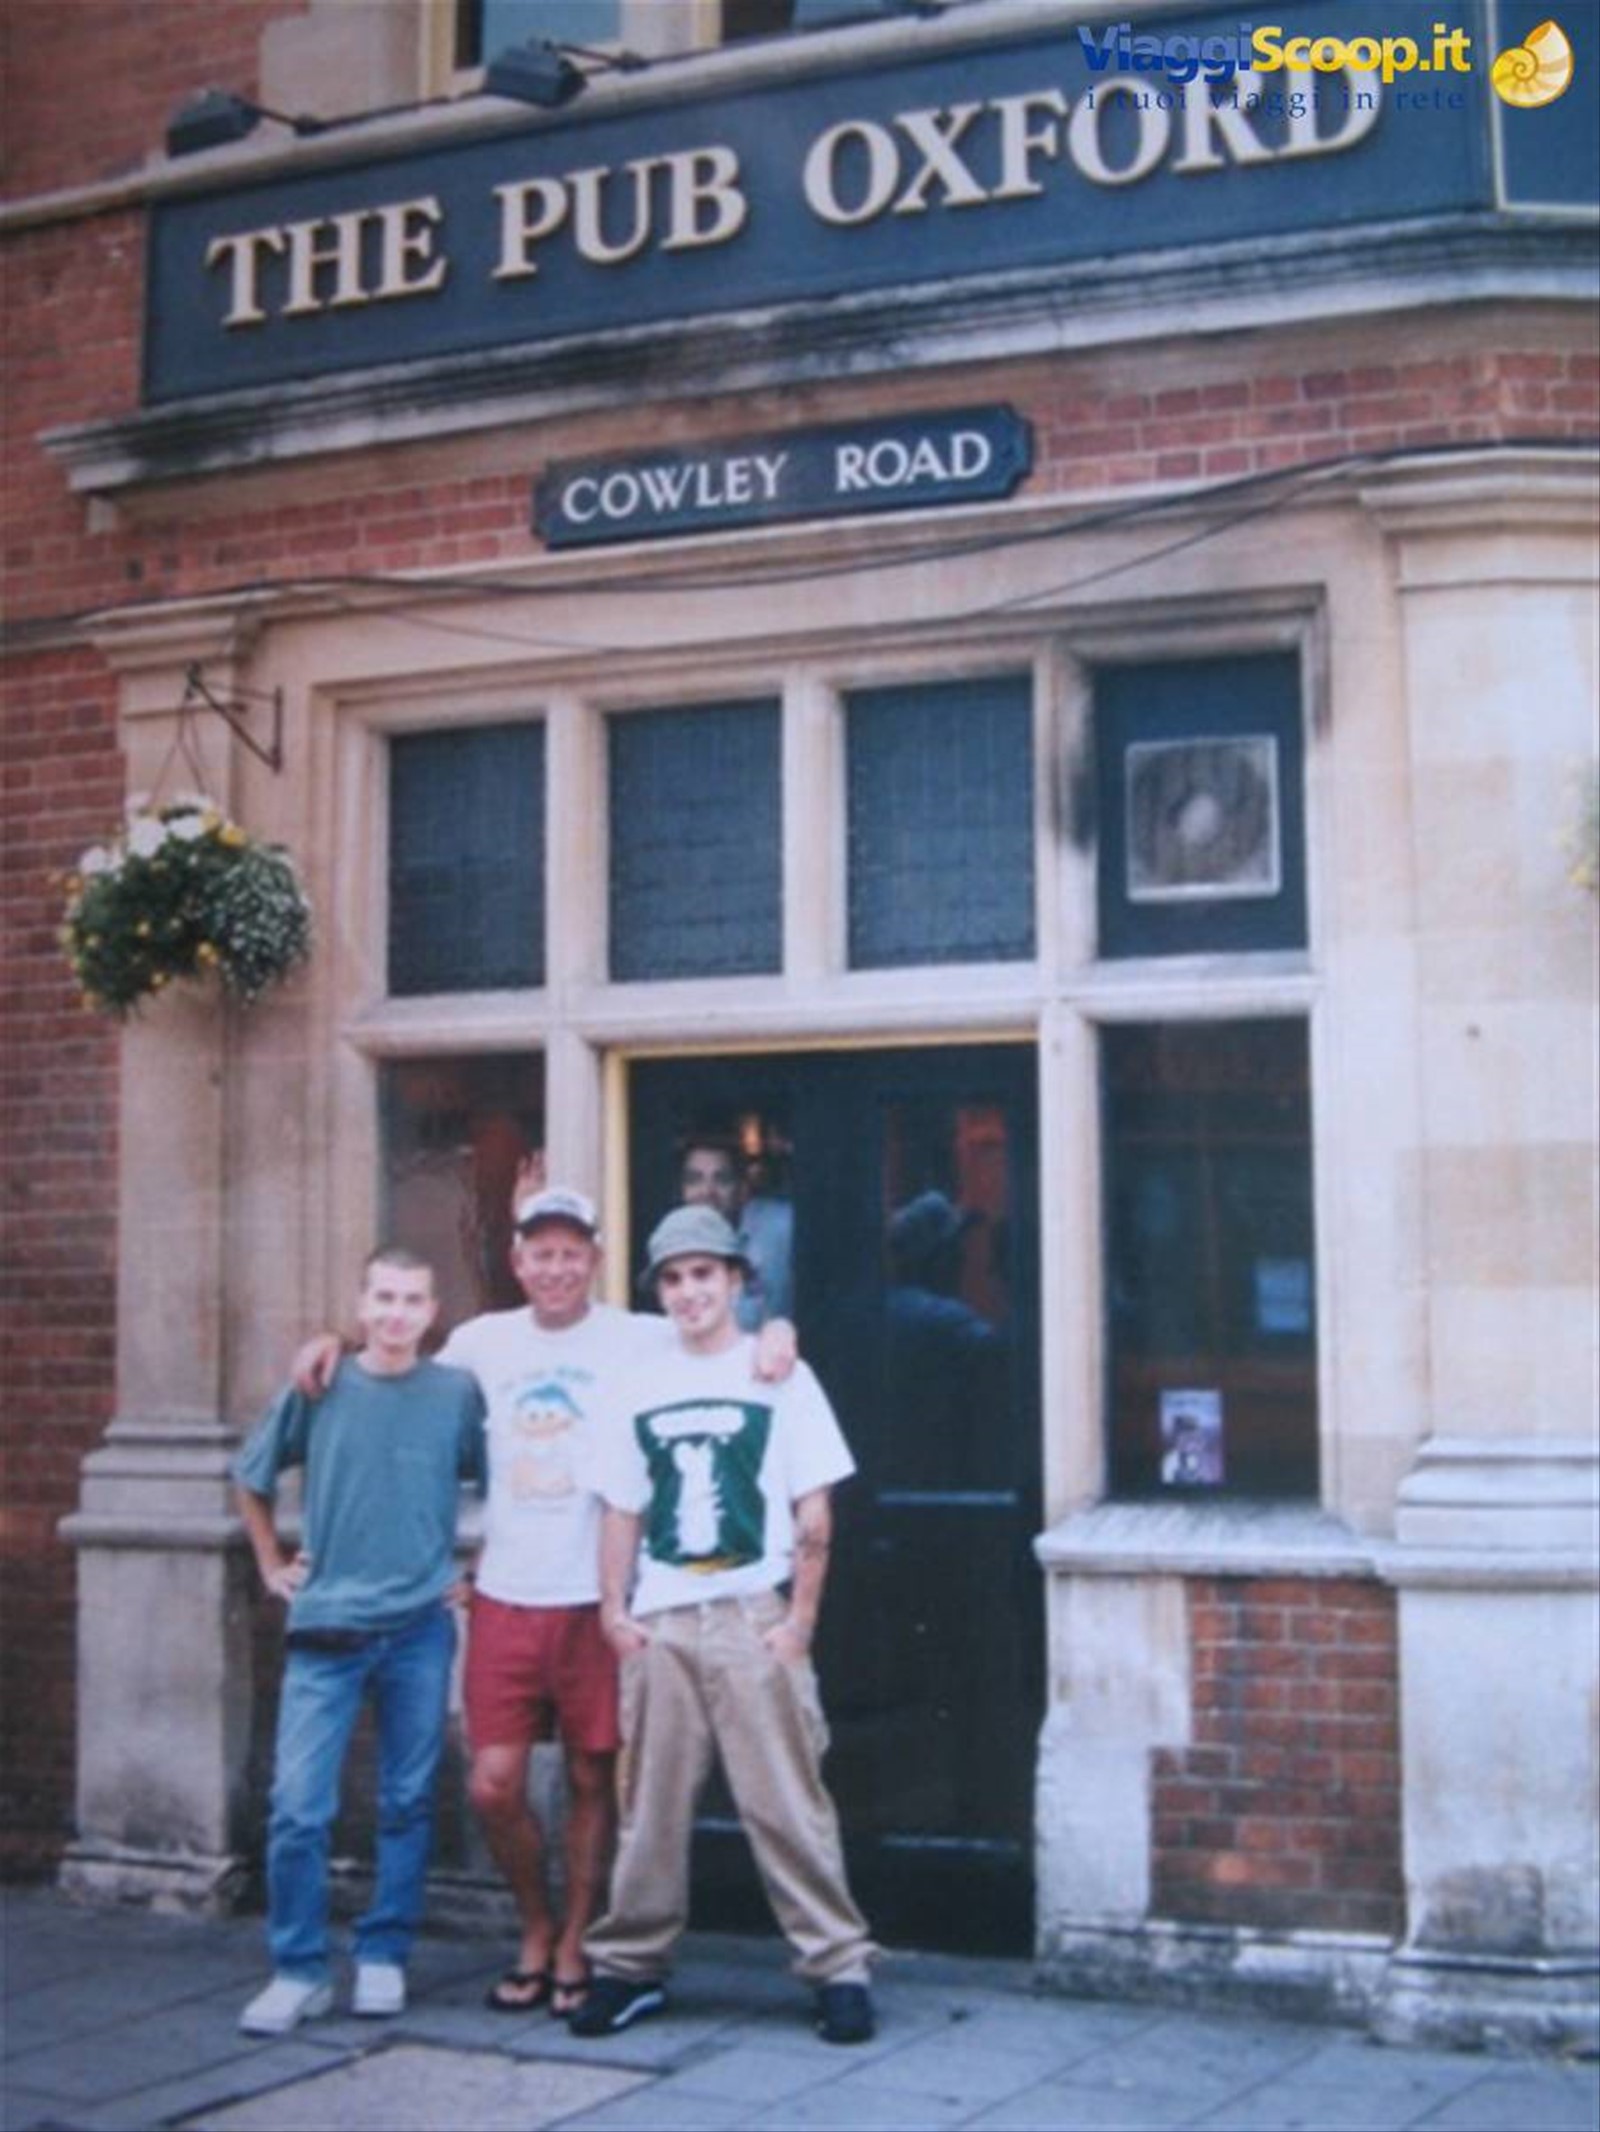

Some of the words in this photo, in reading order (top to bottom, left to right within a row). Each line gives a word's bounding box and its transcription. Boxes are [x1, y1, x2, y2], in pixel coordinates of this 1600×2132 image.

[207, 196, 446, 324] THE
[491, 146, 747, 279] PUB
[803, 66, 1382, 224] OXFORD
[561, 454, 788, 522] COWLEY
[836, 431, 990, 491] ROAD
